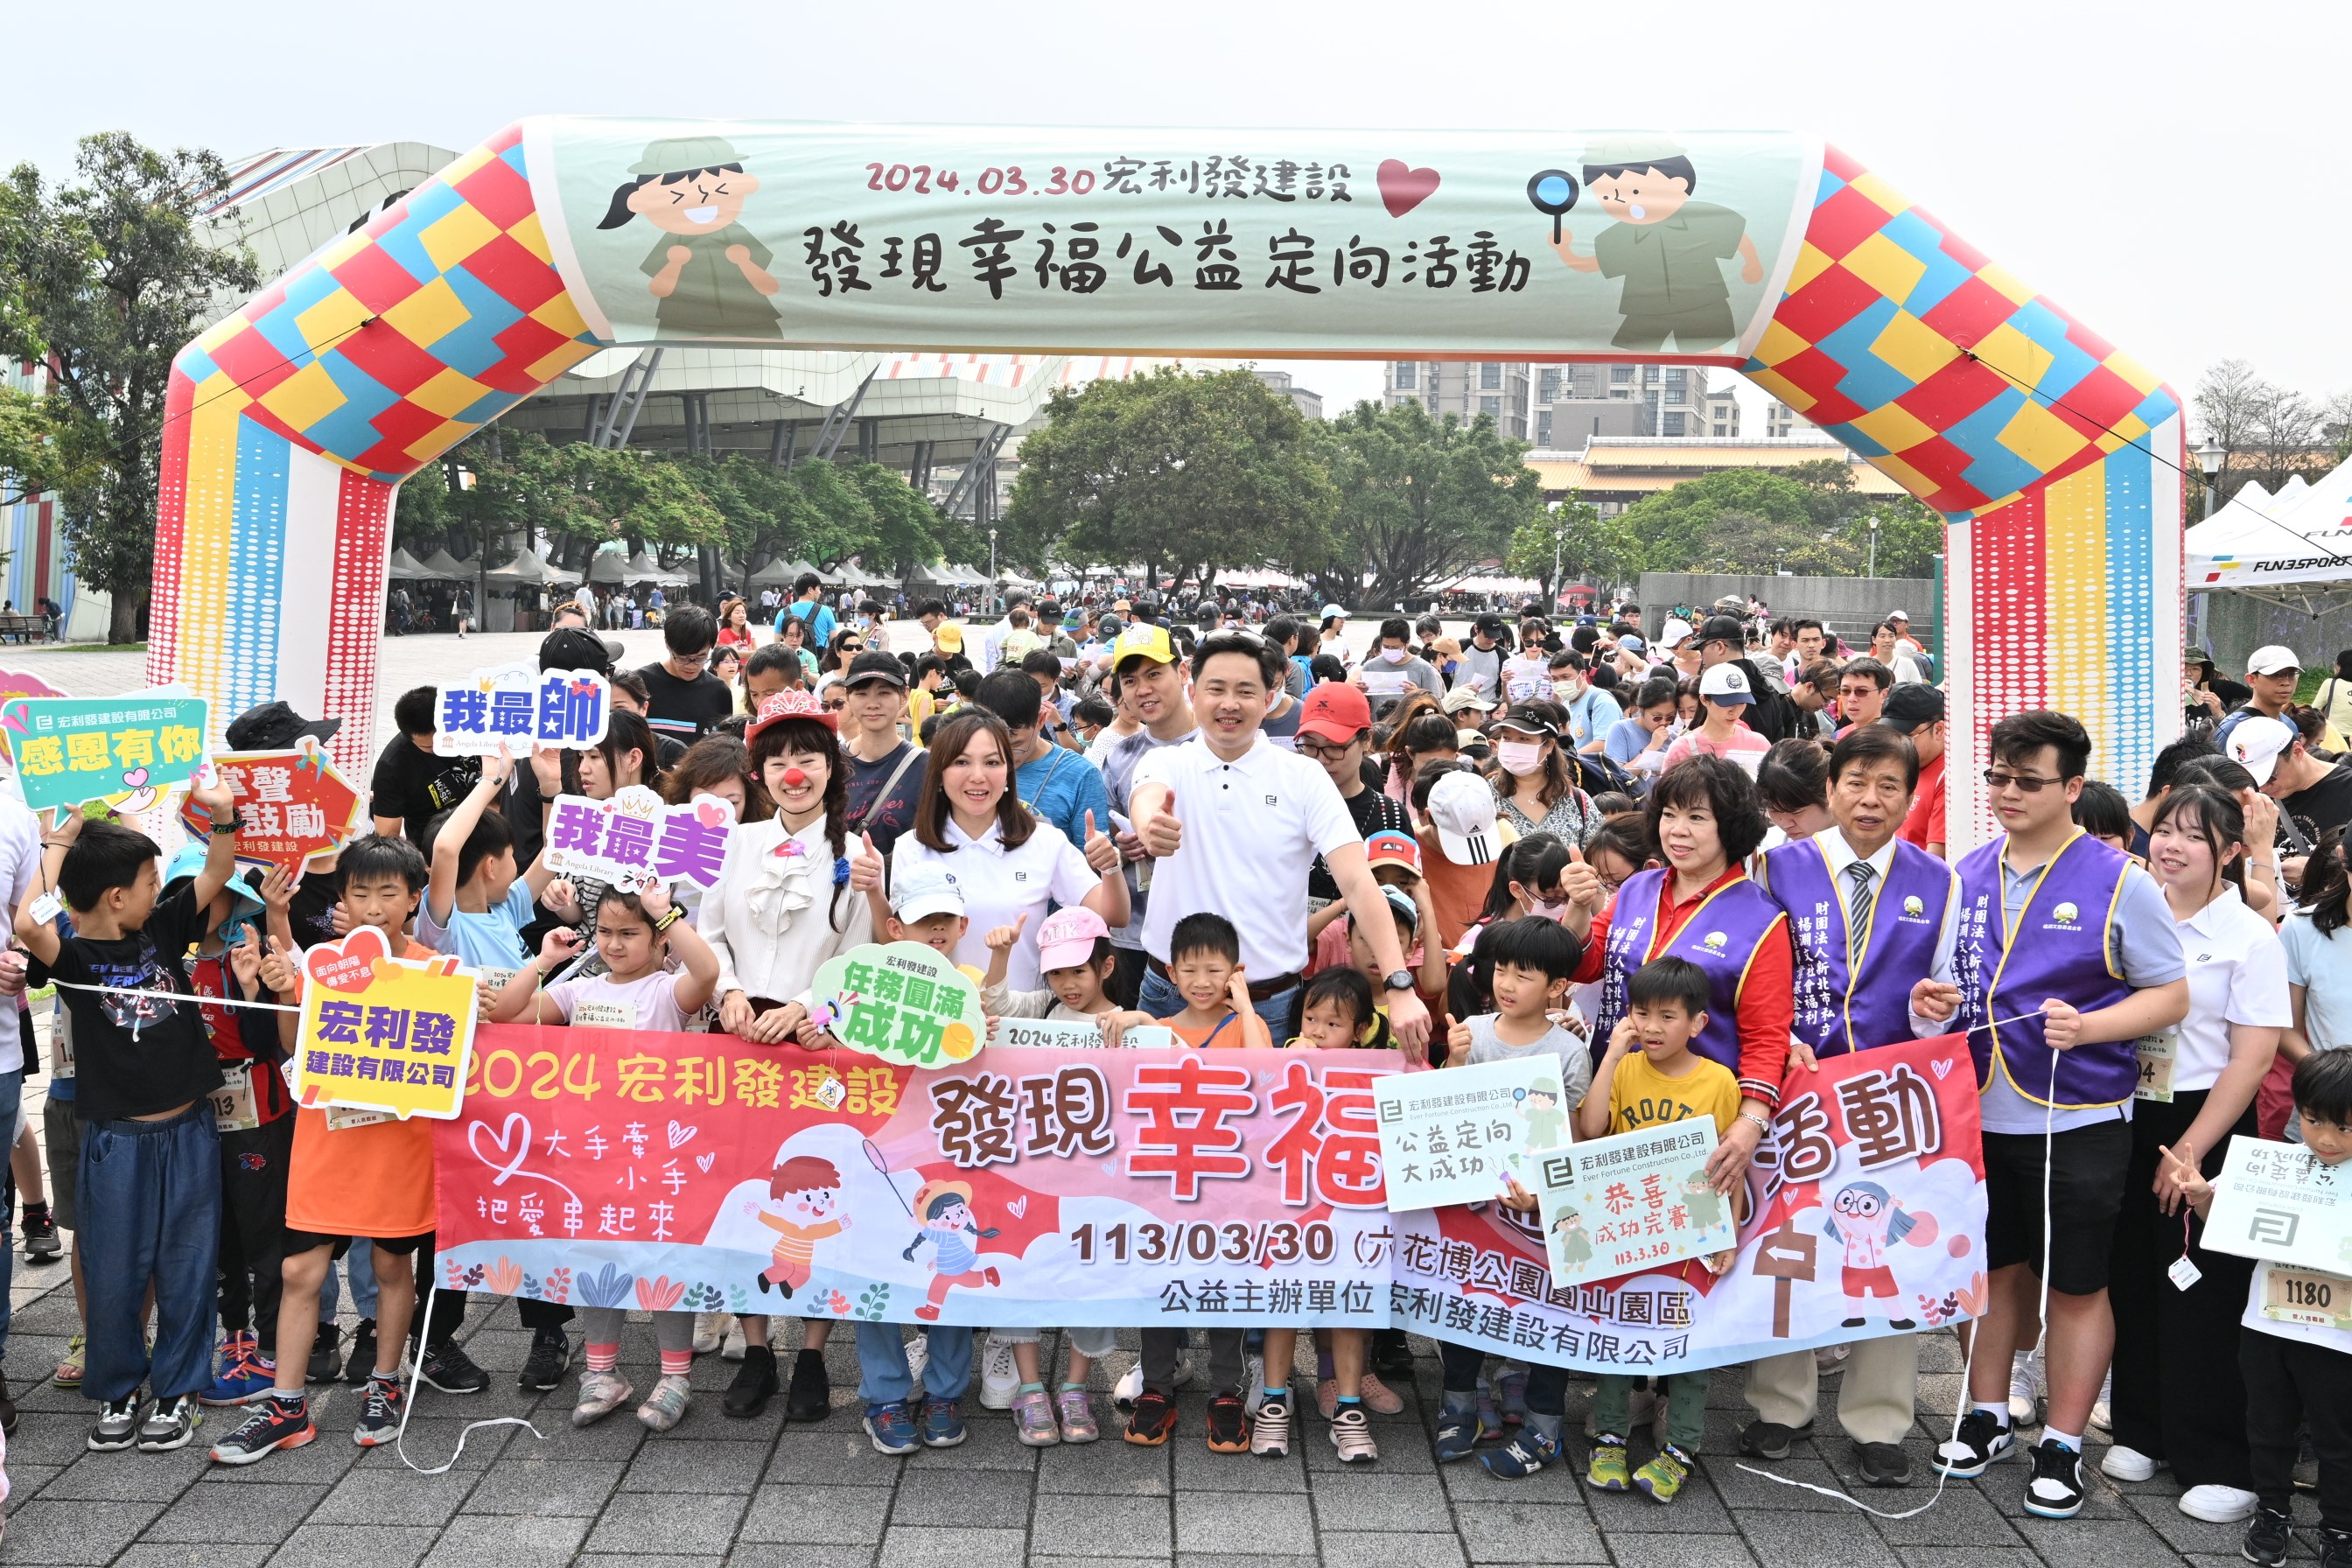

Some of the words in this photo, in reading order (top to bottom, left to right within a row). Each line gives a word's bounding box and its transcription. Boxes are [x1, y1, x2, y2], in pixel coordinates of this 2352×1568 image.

[866, 161, 1095, 196] 2024.03.30
[1103, 155, 1353, 202] 宏利發建設
[58, 707, 177, 729] 宏利發建設有限公司
[444, 677, 600, 741] 我最帥
[20, 724, 202, 777] 感恩有你
[456, 739, 480, 749] Angela
[482, 740, 502, 749] Librar
[239, 802, 325, 838] 鼓勵
[553, 803, 729, 888] 我最美
[564, 859, 589, 872] Angela
[315, 956, 361, 978] 面向朝陽
[326, 967, 372, 988] 傳愛不息
[886, 956, 938, 978] 宏利發建設
[844, 961, 966, 1020] 任務圓滿
[316, 1000, 457, 1056] 宏利發
[844, 1002, 947, 1064] 成功
[1009, 1029, 1052, 1046] 2024
[1055, 1031, 1139, 1049] 宏利發設
[305, 1050, 456, 1089] 建設有限公司
[616, 1054, 898, 1116] 宏利發建設
[1409, 1088, 1510, 1111] 宏利發建設有限公司
[1424, 1110, 1449, 1119] Fortune
[1450, 1105, 1489, 1116] Construction
[1396, 1119, 1512, 1154] 公益定向
[1580, 1131, 1705, 1171] 宏利發建設有限公司
[616, 1158, 688, 1196] 小手
[1402, 1154, 1484, 1183] 大成功
[1583, 1172, 1600, 1182] Ever
[1600, 1167, 1631, 1179] Fortune
[1632, 1157, 1679, 1172] Construction
[1604, 1172, 1667, 1215] 恭喜
[477, 1193, 675, 1242] 把愛串起來
[1595, 1204, 1689, 1245] 成功完賽
[1071, 1222, 1335, 1264] 113/03/30
[1614, 1242, 1670, 1266] 113.3.30
[1159, 1278, 1374, 1314] 公益主辦單位
[2286, 1279, 2332, 1308] 1180
